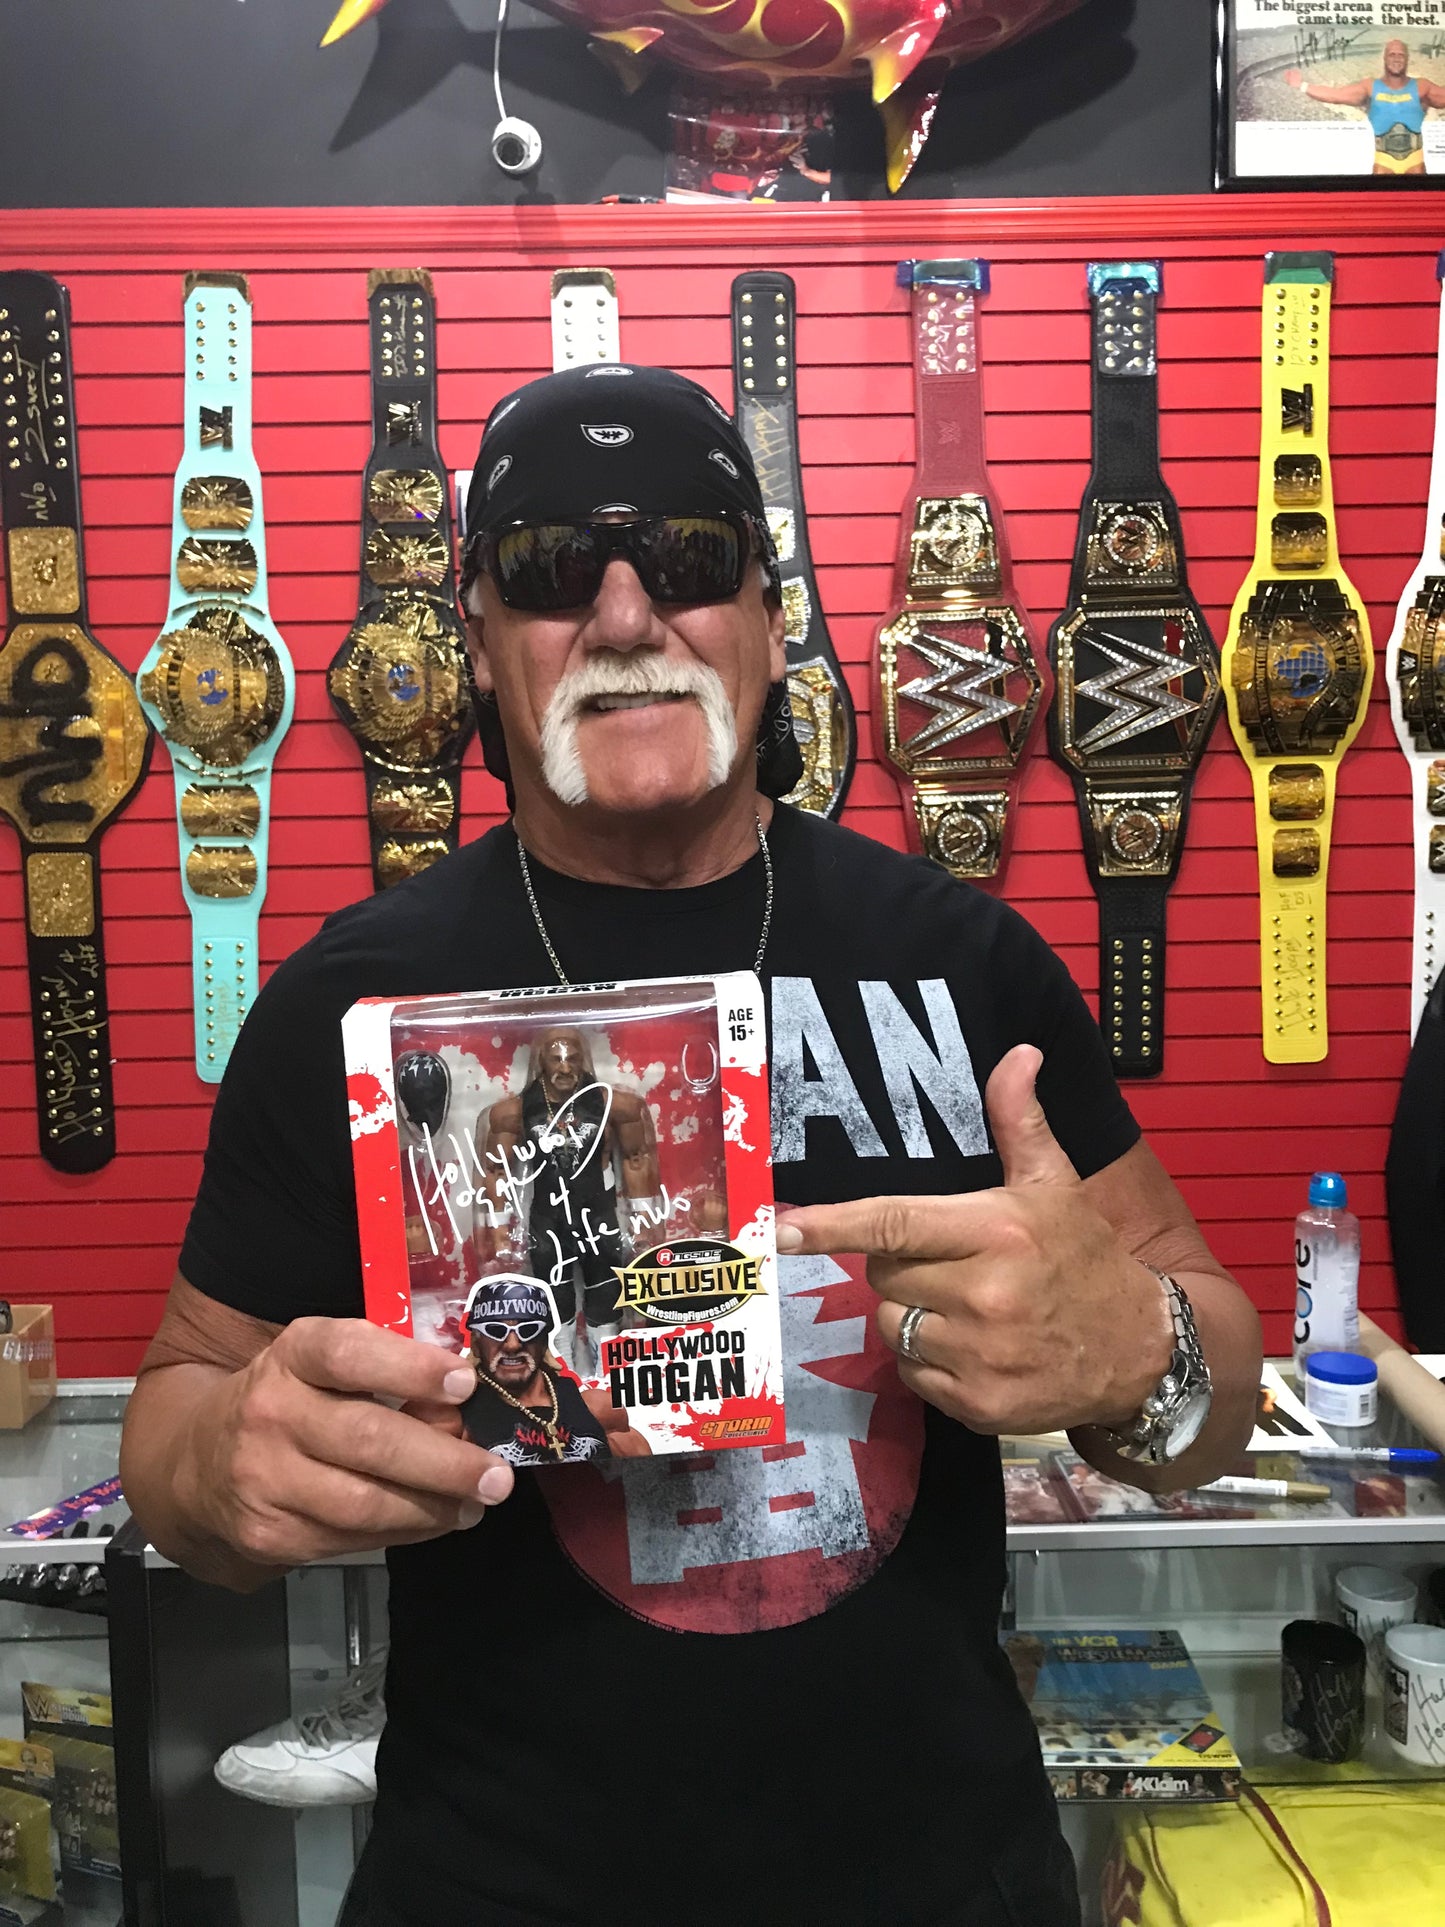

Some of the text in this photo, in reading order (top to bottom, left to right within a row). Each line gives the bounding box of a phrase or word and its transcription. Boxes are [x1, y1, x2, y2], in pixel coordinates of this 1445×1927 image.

[1255, 0, 1439, 15] The biggest arena crowd in
[1297, 13, 1440, 26] came to see the best.
[728, 1008, 753, 1022] AGE
[728, 1024, 755, 1042] 15+
[550, 1176, 573, 1225] 4
[623, 1261, 757, 1302] EXCLUSIVE
[1294, 1238, 1313, 1344] core
[473, 1298, 548, 1320] HOLLYWOOD
[646, 1297, 739, 1322] WrestlingFigures.com
[607, 1330, 745, 1366] HOLLYWOOD
[609, 1356, 746, 1409] HOGAN
[700, 1416, 773, 1439] STORM
[1073, 1635, 1119, 1647] VCR
